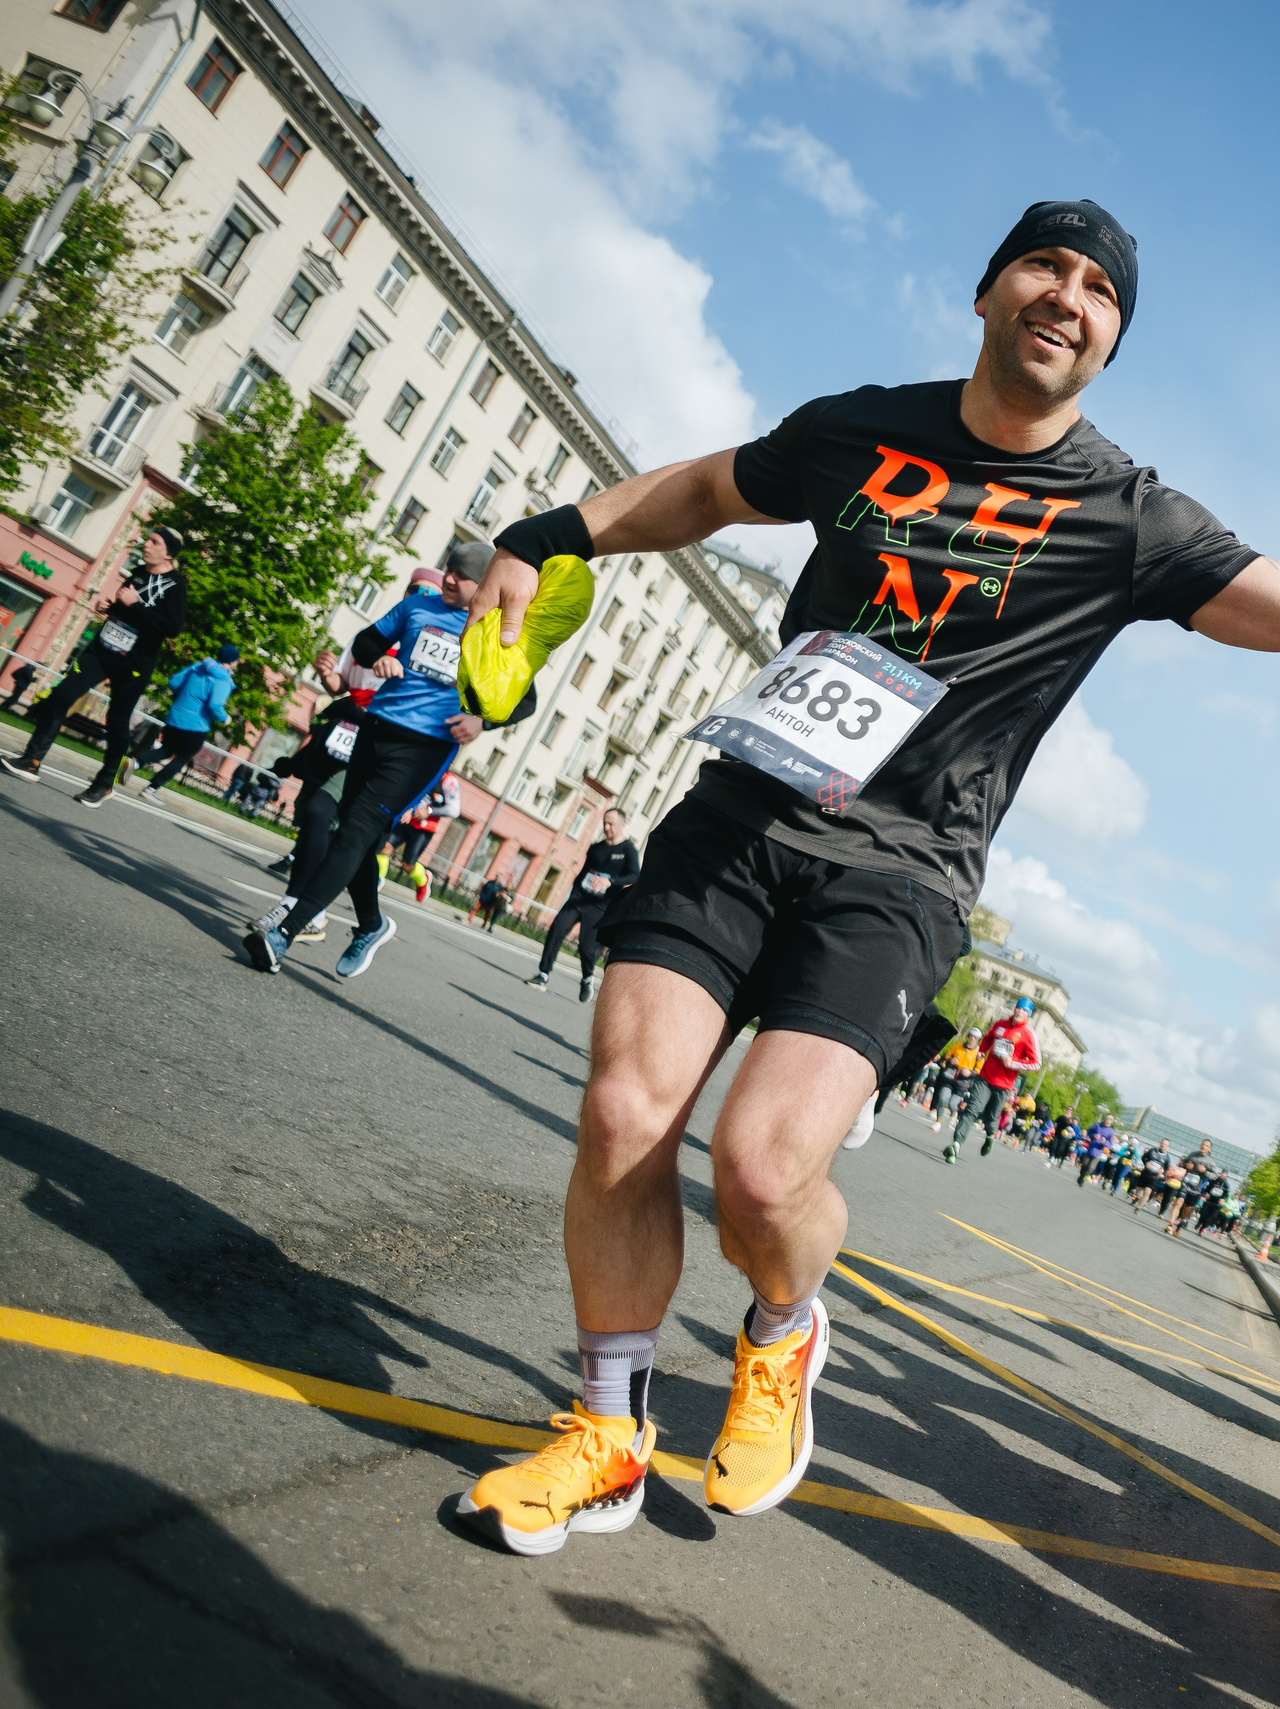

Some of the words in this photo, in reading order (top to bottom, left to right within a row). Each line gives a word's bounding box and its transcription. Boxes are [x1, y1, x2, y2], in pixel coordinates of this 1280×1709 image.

[1036, 212, 1088, 233] PETZL
[18, 550, 54, 580] Кафе
[421, 638, 460, 666] 1212
[757, 665, 883, 741] 8683
[765, 705, 816, 738] АНТОН
